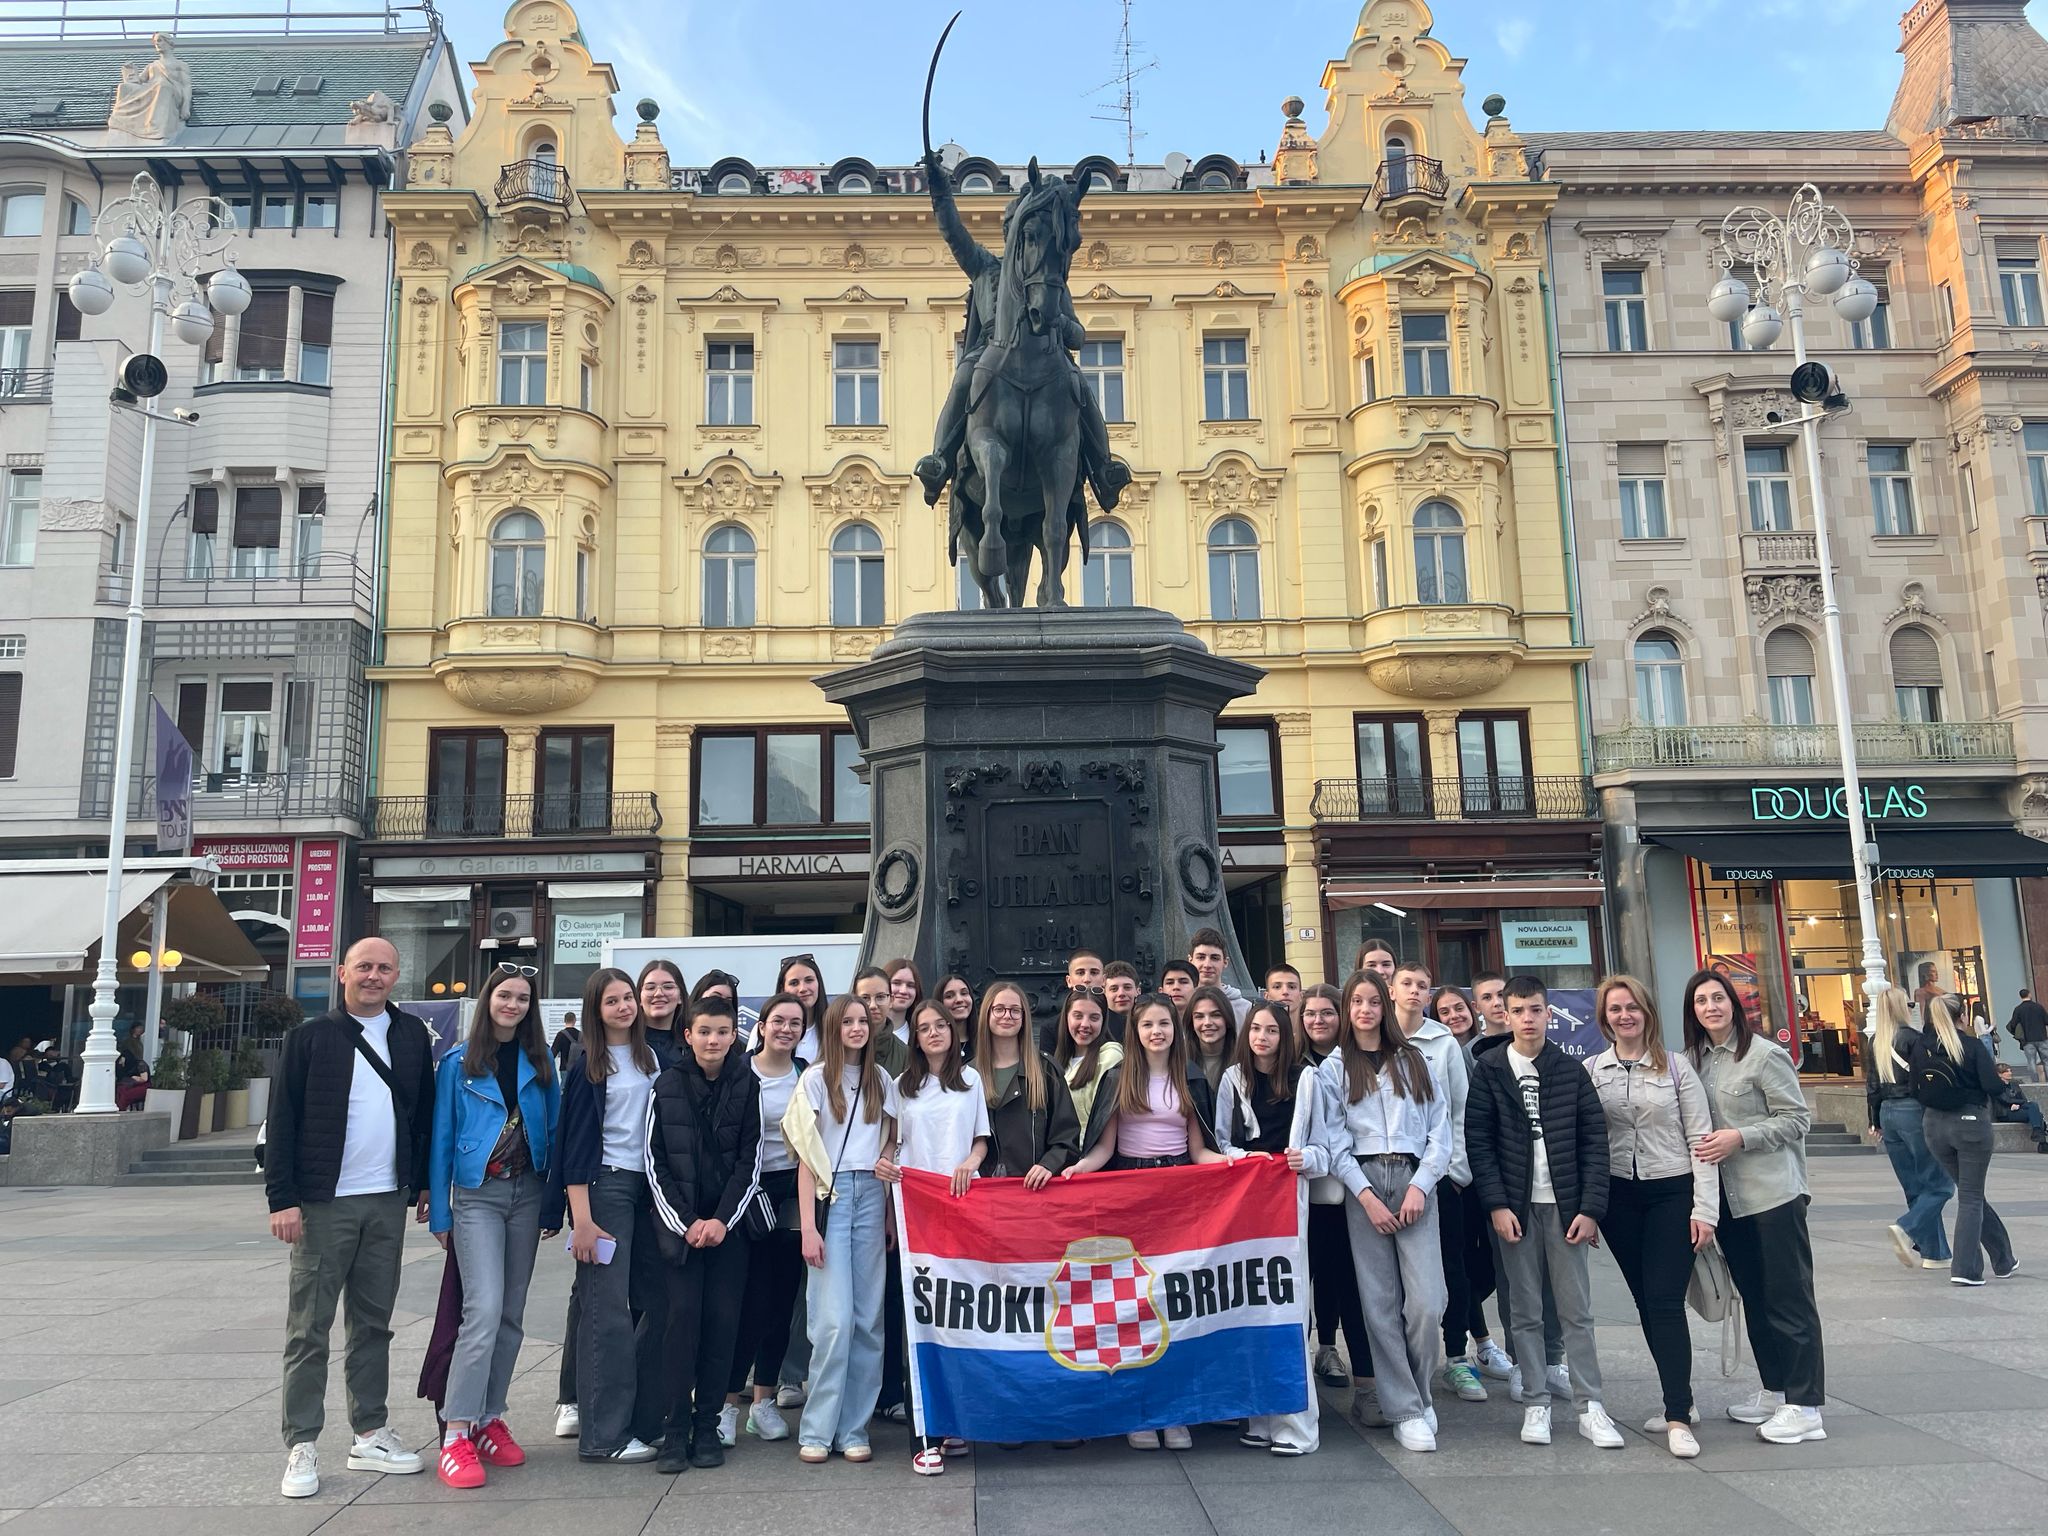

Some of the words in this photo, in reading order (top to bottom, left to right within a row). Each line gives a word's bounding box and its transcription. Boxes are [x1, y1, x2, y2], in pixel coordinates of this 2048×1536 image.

[1014, 823, 1081, 856] BAN
[202, 844, 229, 855] ZAKUP
[230, 843, 290, 854] EKSKLUZIVNOG
[247, 854, 289, 864] PROSTORA
[459, 857, 539, 874] Galerija
[557, 855, 605, 871] Mala
[307, 863, 333, 872] PROSTORI
[739, 855, 845, 875] HARMICA
[1726, 869, 1774, 880] DOUGLAS
[1887, 868, 1935, 879] DOUGLAS
[244, 896, 251, 904] 5
[573, 922, 602, 930] Galerija
[1539, 925, 1573, 933] LOKACIJA
[1021, 925, 1081, 951] 1848
[558, 939, 578, 949] Pod
[581, 939, 602, 949] zido
[912, 1266, 1046, 1334] ŠIROKI
[1163, 1255, 1296, 1321] BRIJEG
